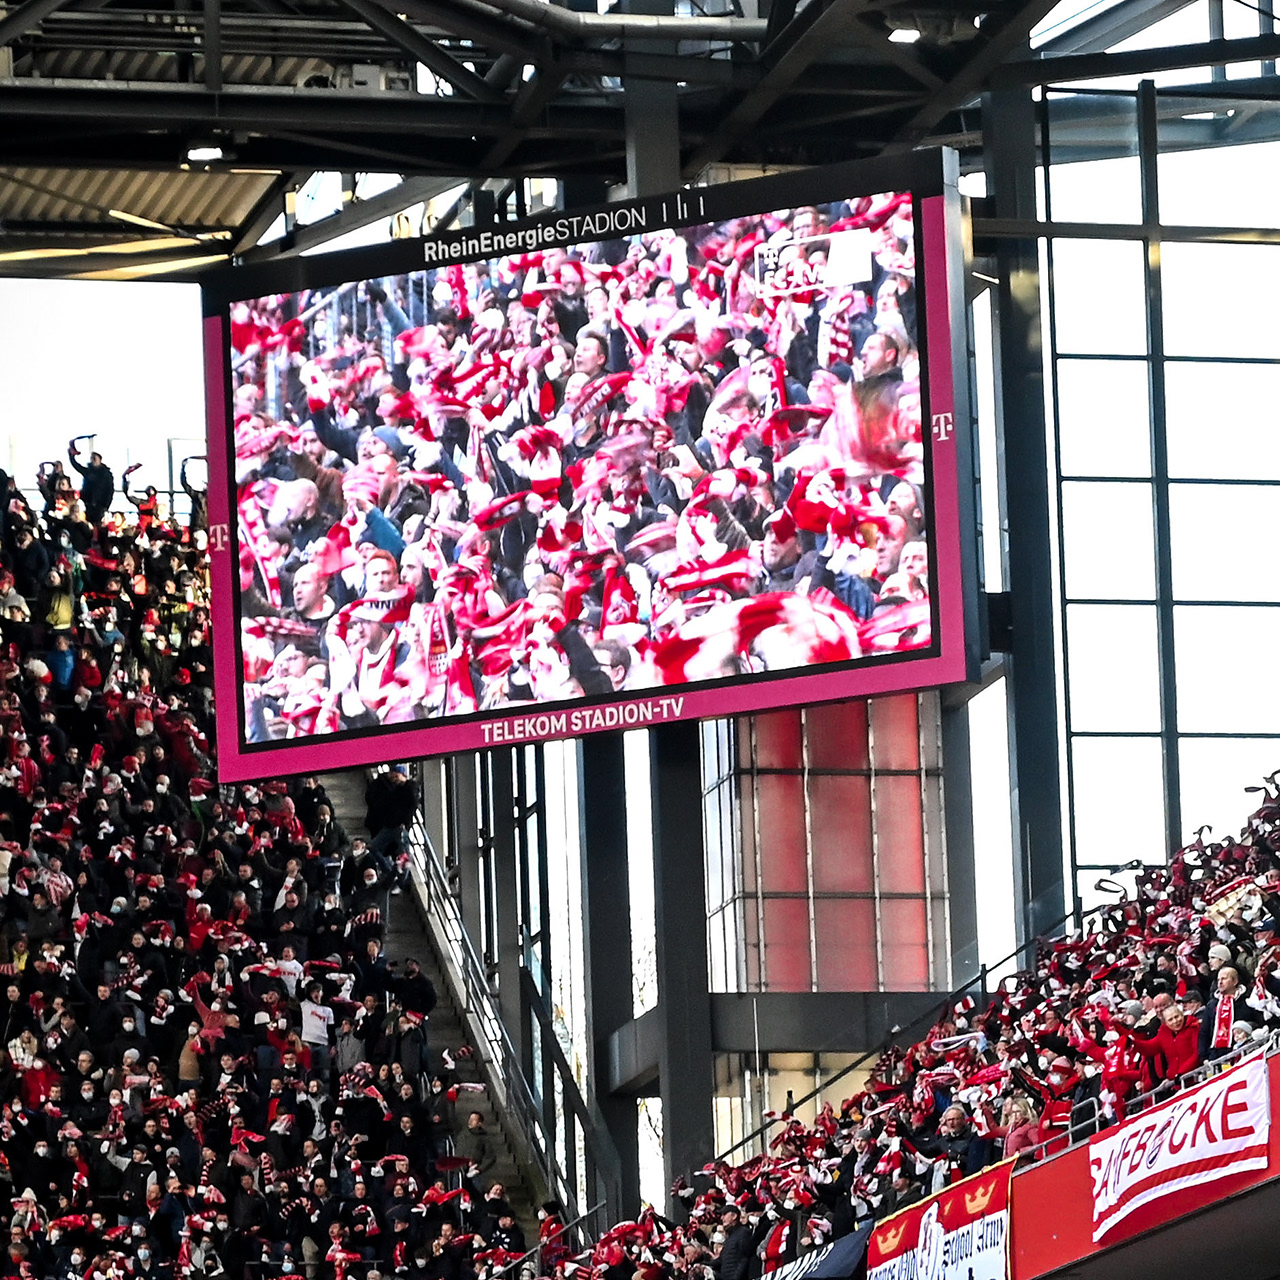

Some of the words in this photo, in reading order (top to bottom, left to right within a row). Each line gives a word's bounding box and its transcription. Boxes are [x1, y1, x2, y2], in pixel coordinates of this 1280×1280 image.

[424, 206, 647, 262] RheinEnergieSTADION
[481, 713, 567, 743] TELEKOM
[571, 697, 684, 731] STADION-TV
